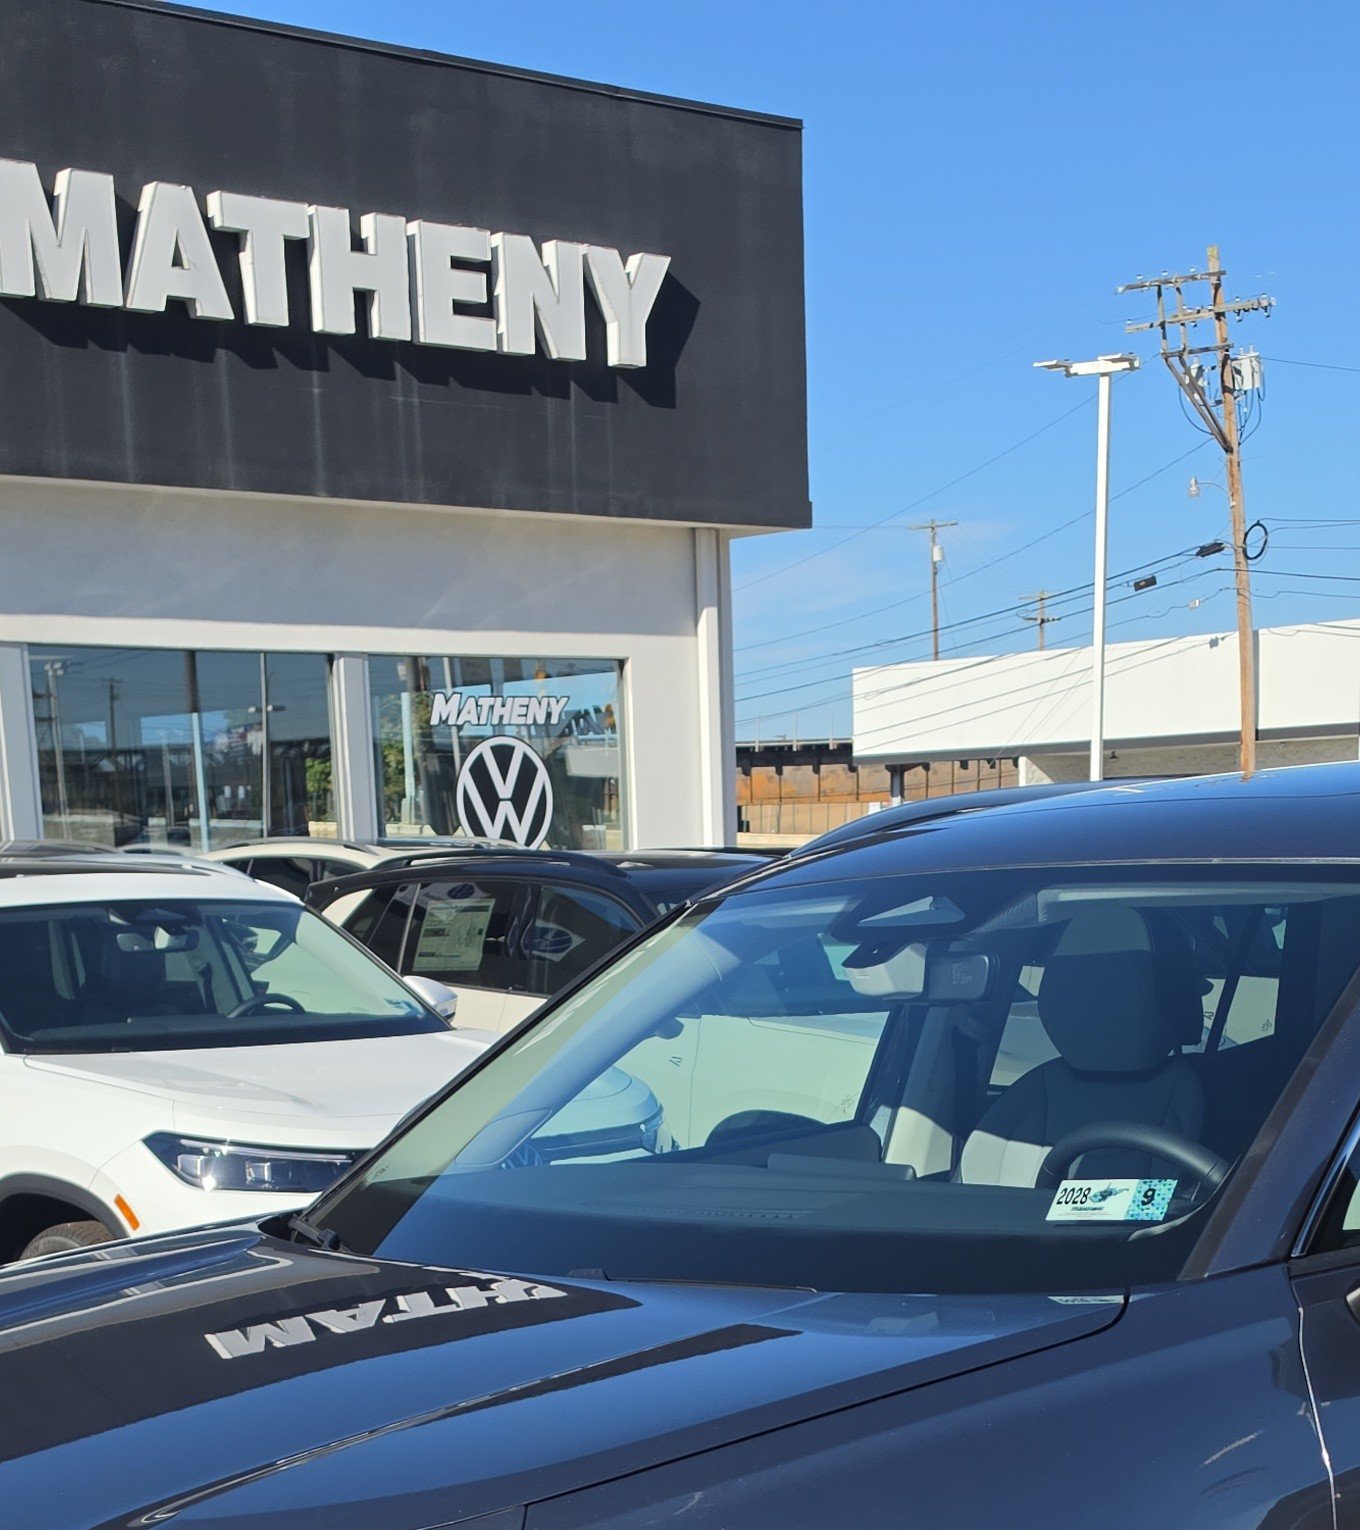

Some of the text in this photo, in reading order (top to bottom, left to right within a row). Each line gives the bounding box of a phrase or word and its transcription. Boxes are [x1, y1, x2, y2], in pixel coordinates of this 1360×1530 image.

[430, 693, 569, 725] MATHENY
[1057, 1186, 1093, 1205] 2028
[1141, 1187, 1156, 1207] 9
